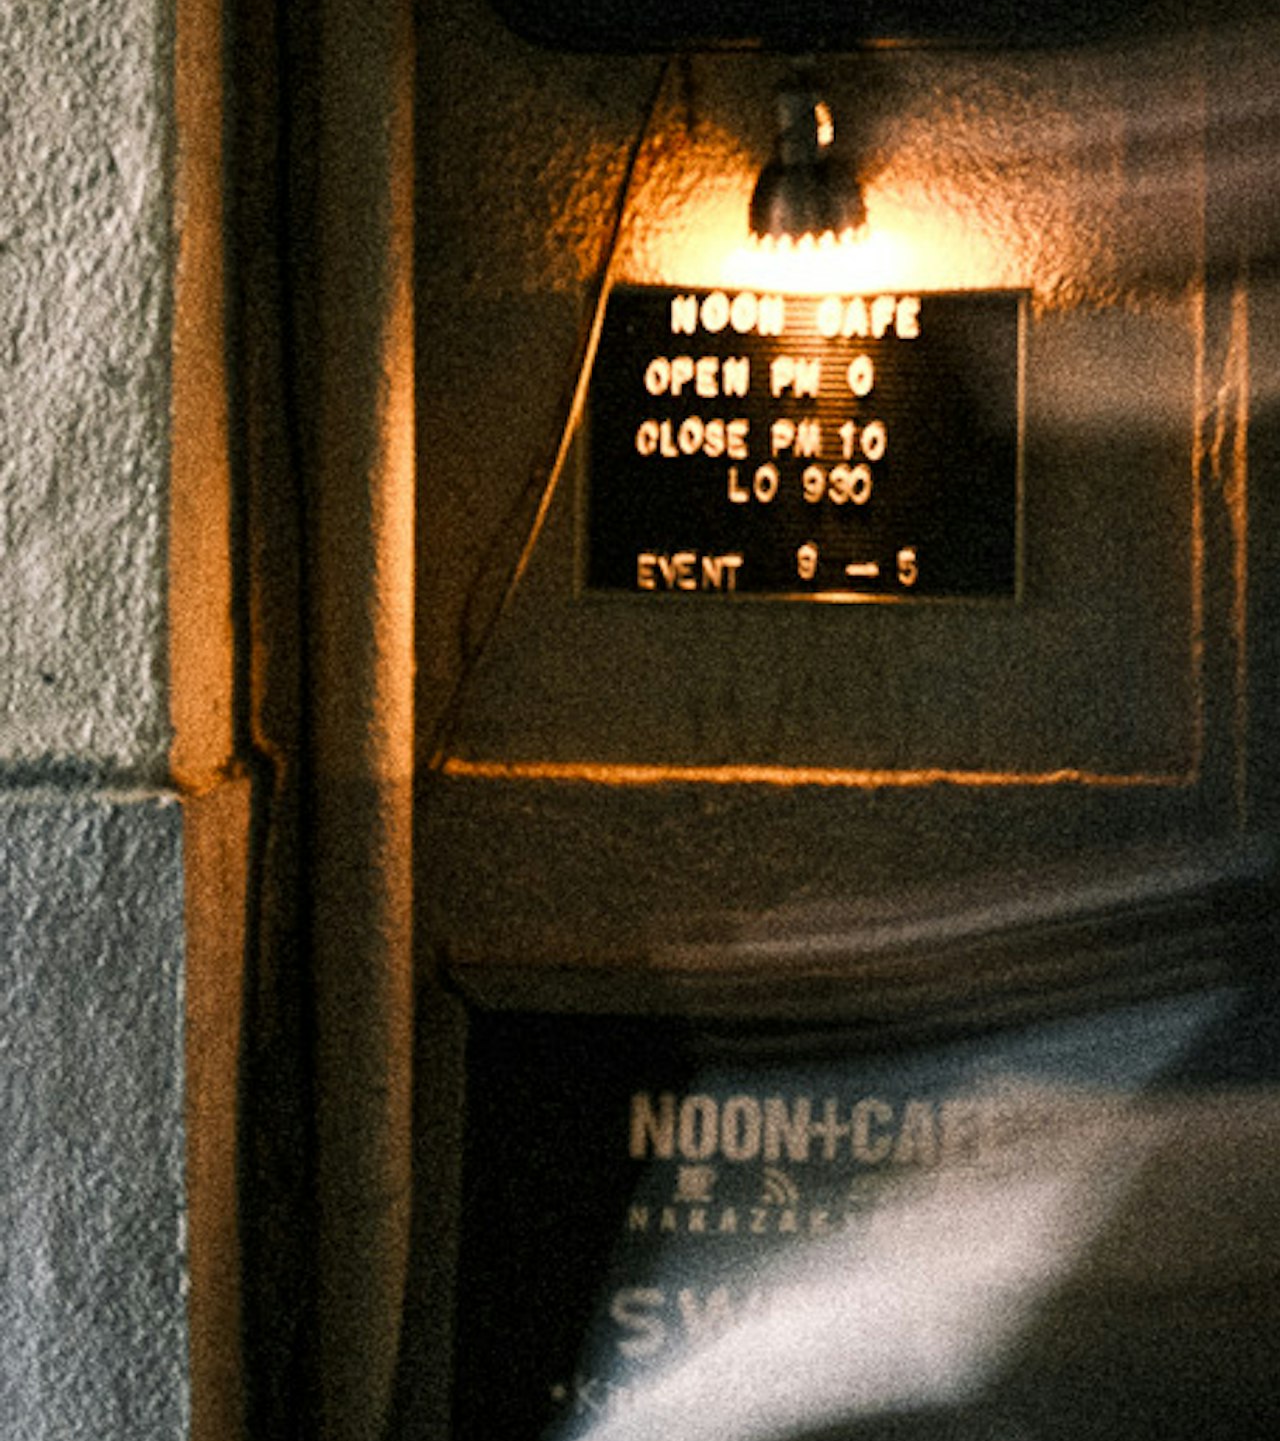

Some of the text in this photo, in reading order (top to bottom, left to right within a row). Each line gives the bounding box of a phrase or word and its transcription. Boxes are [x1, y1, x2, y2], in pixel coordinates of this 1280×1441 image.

[671, 291, 785, 336] NOON
[645, 356, 750, 397] OPEN
[771, 355, 822, 397] PM
[636, 416, 887, 462] CLOSE PM 10
[637, 553, 743, 591] EVENT
